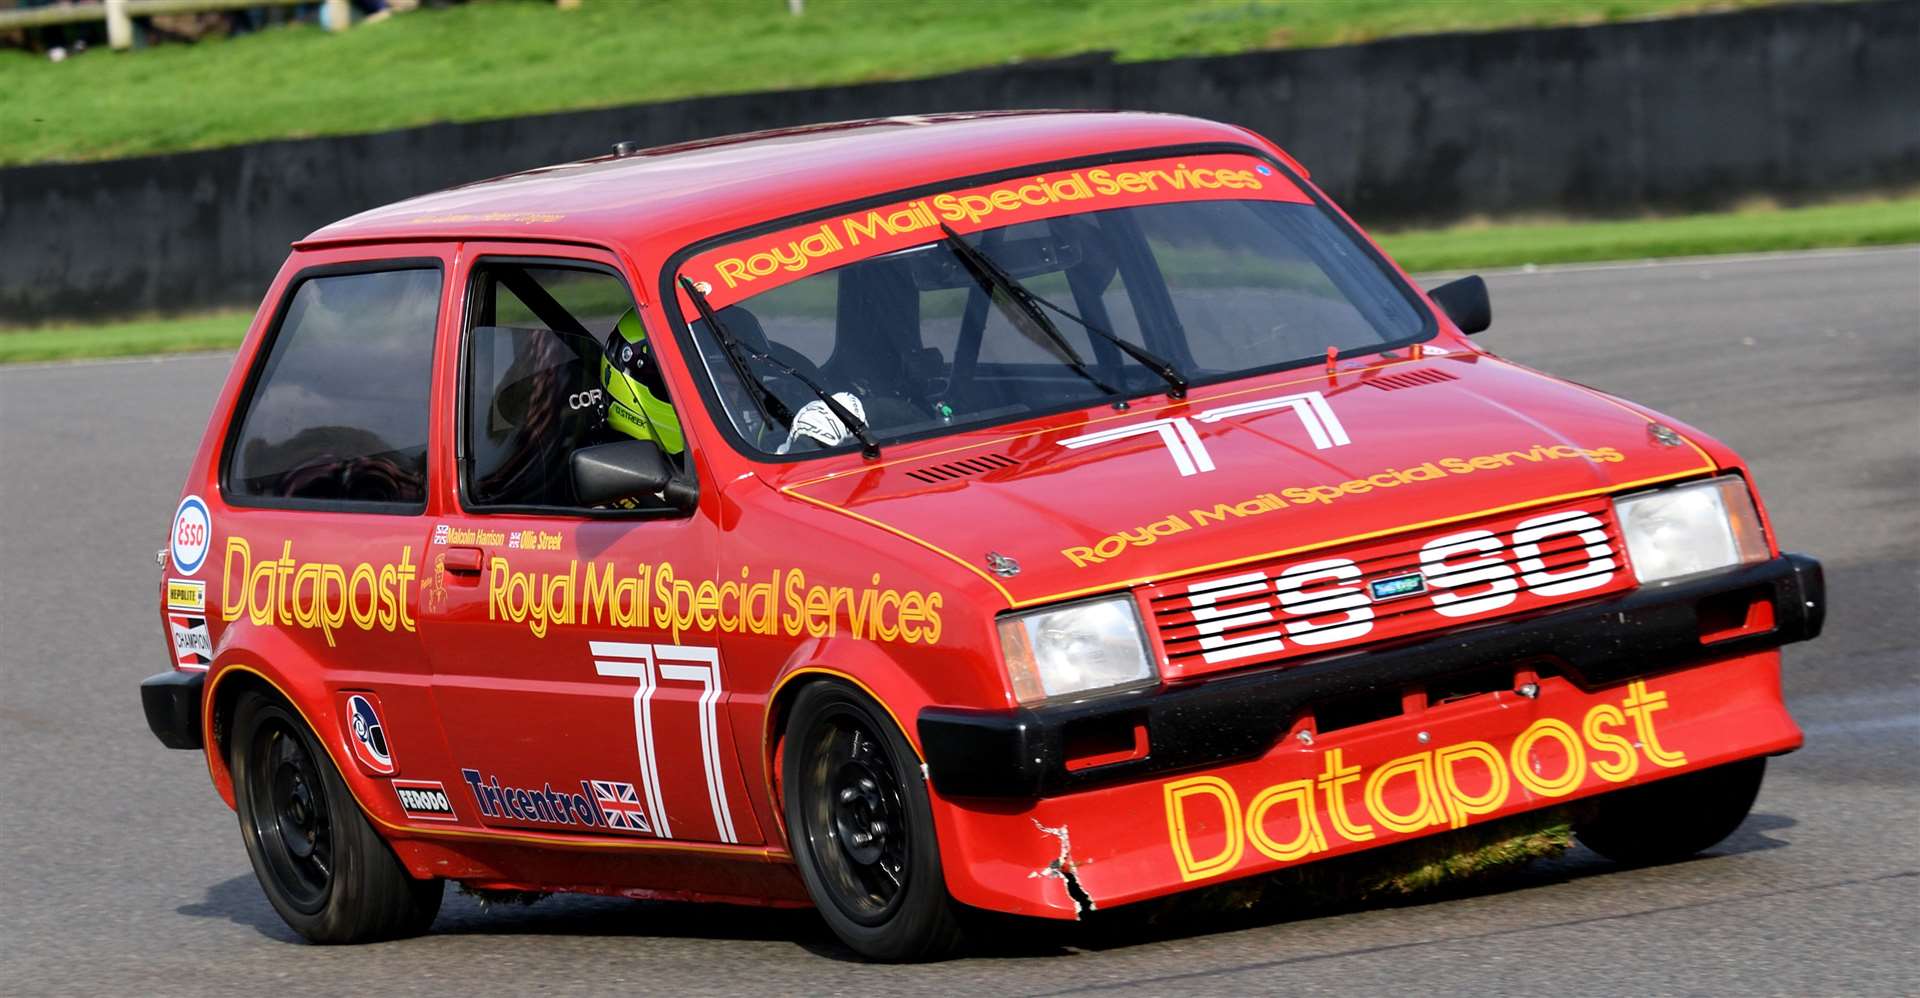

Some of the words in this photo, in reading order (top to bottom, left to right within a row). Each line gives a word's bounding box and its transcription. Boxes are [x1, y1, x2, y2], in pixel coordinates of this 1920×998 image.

[715, 224, 842, 289] Royal
[844, 199, 939, 247] Mail
[933, 171, 1095, 224] Special
[1088, 161, 1263, 196] Services
[1056, 391, 1350, 477] 77
[178, 517, 203, 546] Esso
[447, 528, 476, 545] Malcolm
[476, 530, 505, 546] Harrison
[520, 530, 537, 549] Ollie
[539, 531, 563, 550] Streek
[1061, 512, 1192, 568] Royal
[1190, 489, 1284, 528] Mail
[1281, 461, 1446, 505] Special
[1439, 443, 1625, 476] Services
[170, 588, 196, 601] HEPOLITE
[222, 536, 416, 647] Datapost
[489, 557, 577, 638] Royal
[582, 561, 650, 629] Mail
[655, 565, 778, 646] Special
[783, 568, 943, 644] Services
[176, 632, 209, 652] CHAMPION
[589, 641, 739, 844] 77
[398, 789, 449, 811] FERODO
[462, 768, 607, 828] Tricentrol
[1164, 680, 1687, 882] Datapost
